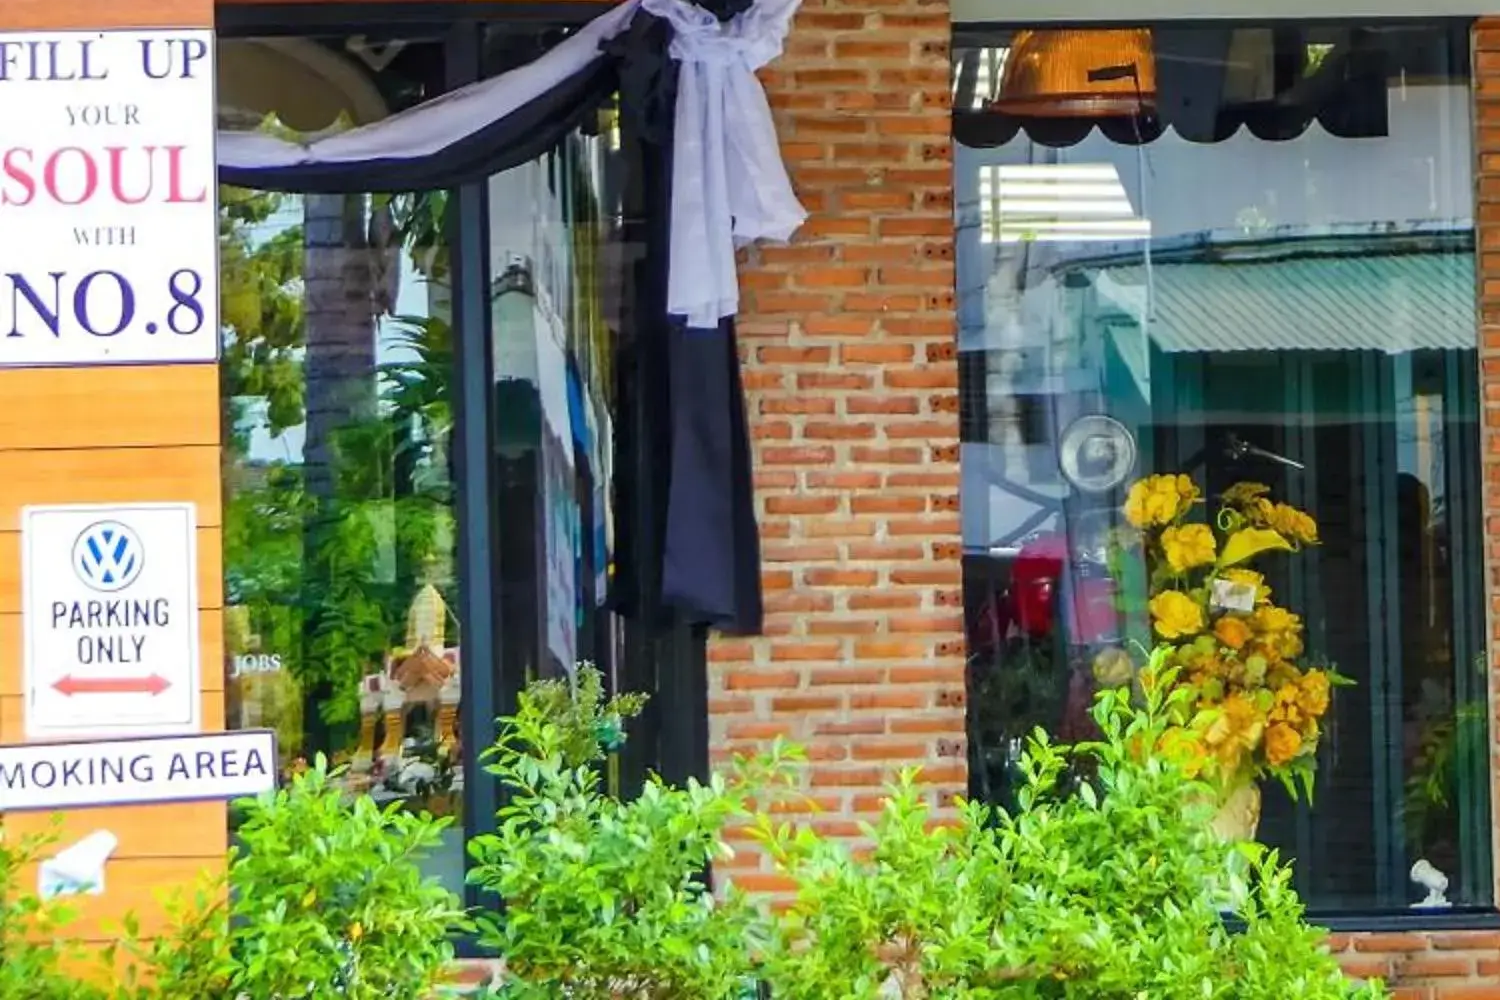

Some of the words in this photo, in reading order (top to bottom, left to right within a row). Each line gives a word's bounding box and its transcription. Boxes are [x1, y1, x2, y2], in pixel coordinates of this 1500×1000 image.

[0, 39, 108, 81] FILL
[138, 38, 208, 79] UP
[65, 104, 141, 126] YOUR
[1, 146, 207, 206] SOUL
[72, 226, 136, 246] WITH
[4, 268, 205, 339] NO.8
[52, 598, 170, 630] PARKING
[77, 635, 146, 665] ONLY
[167, 747, 267, 780] AREA
